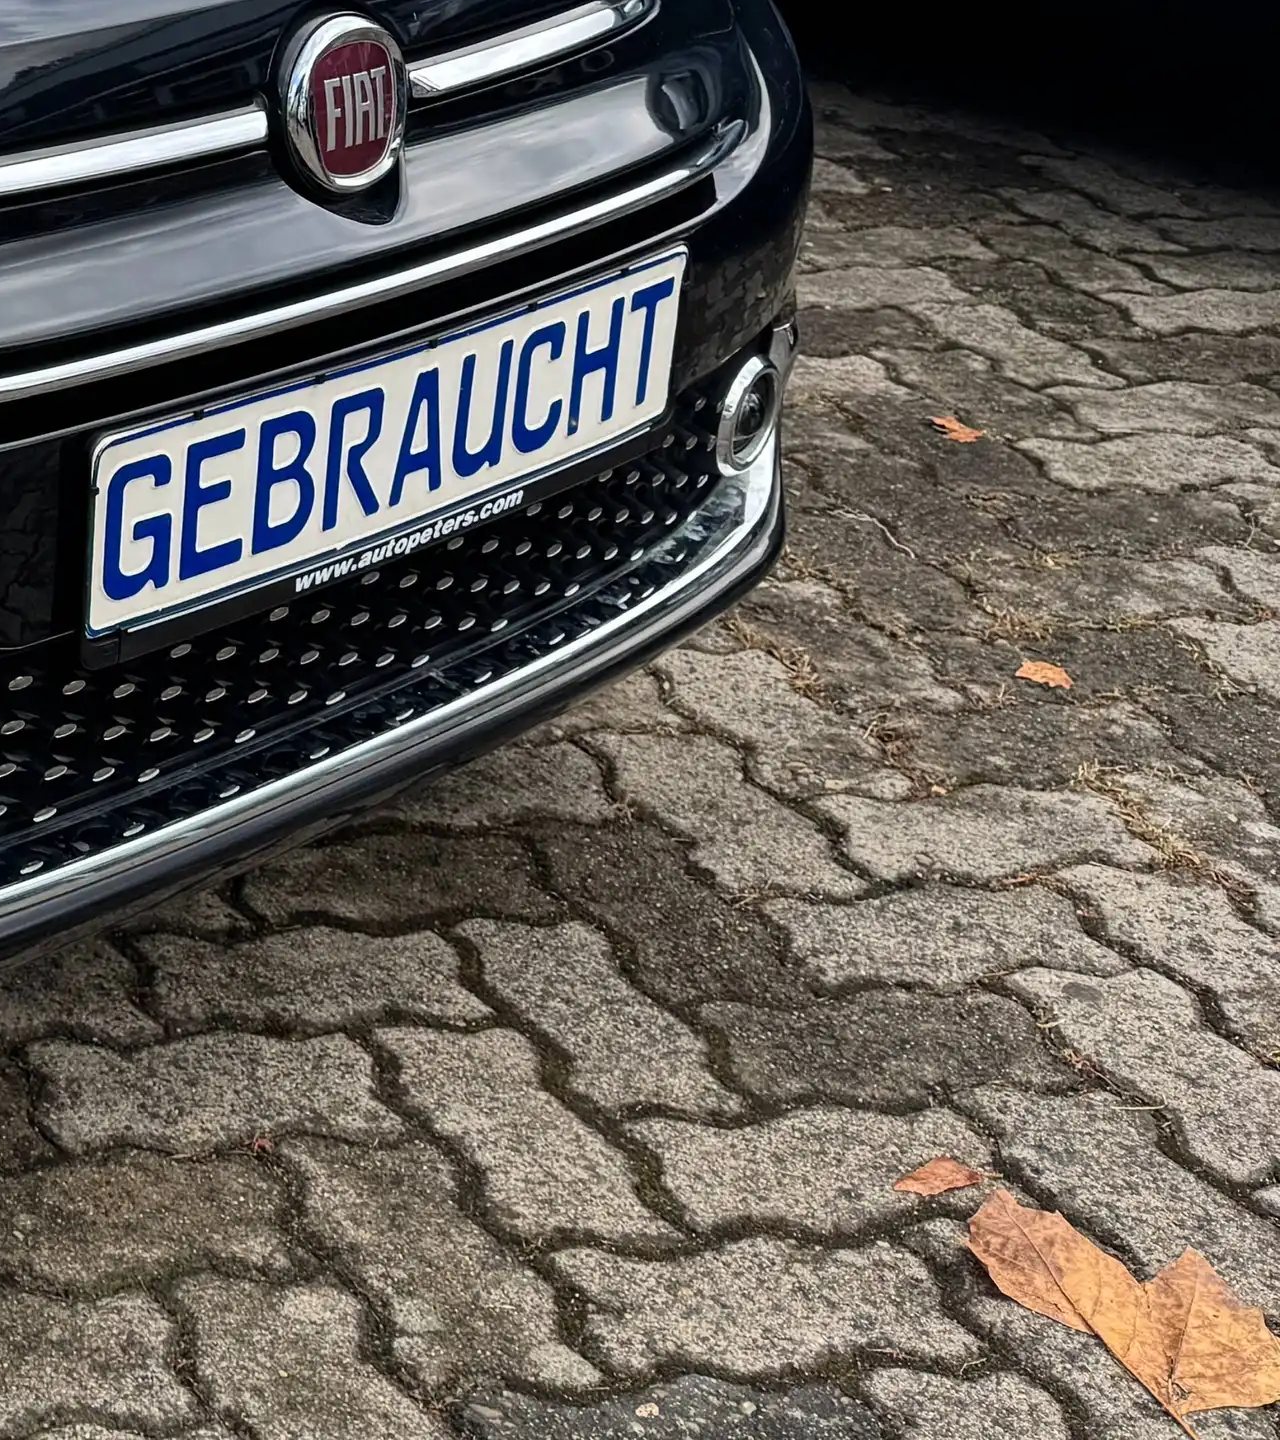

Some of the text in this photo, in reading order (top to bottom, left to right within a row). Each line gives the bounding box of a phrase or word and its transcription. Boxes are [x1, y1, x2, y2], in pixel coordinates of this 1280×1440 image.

[324, 65, 386, 152] FIAT
[101, 275, 676, 602] GEBRAUCHT
[295, 489, 524, 593] www.autopeters.com
